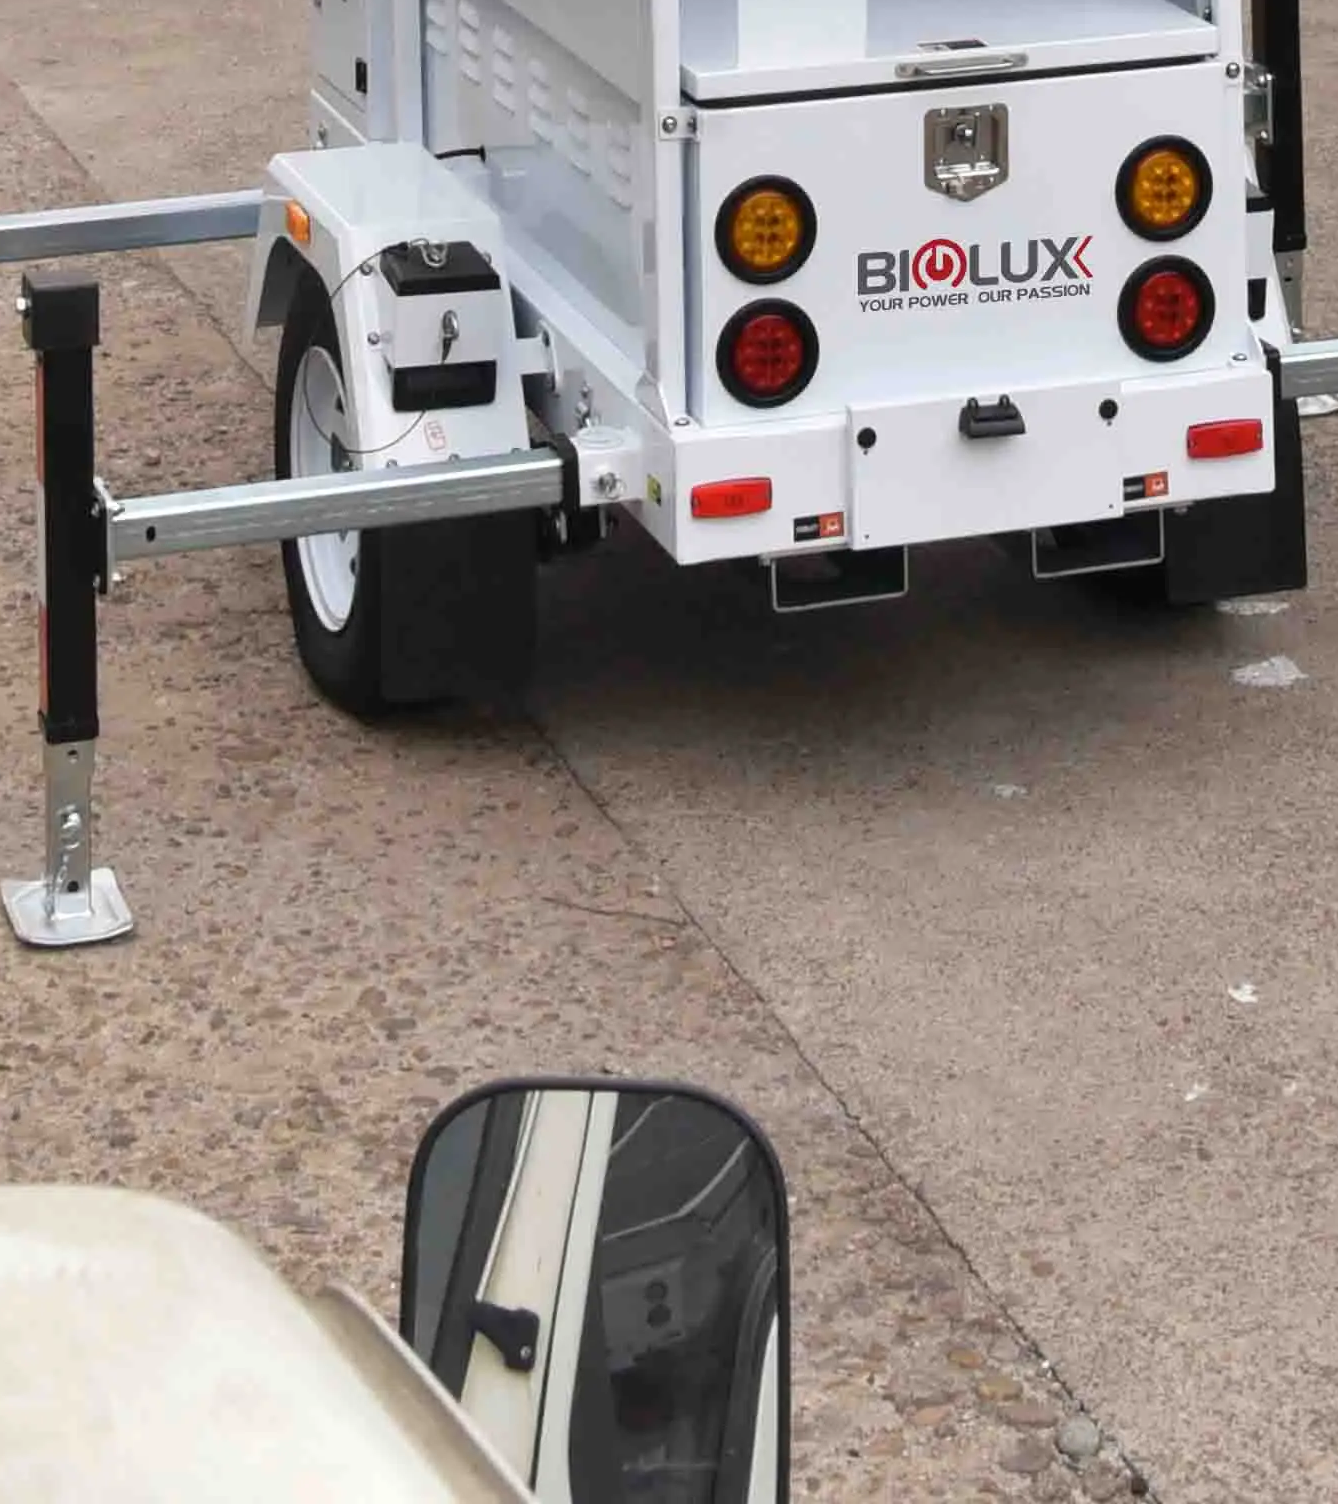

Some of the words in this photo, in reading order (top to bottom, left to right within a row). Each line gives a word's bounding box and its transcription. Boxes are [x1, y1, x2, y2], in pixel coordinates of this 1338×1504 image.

[860, 297, 903, 313] YOUR
[909, 292, 969, 309] POWER
[978, 288, 1012, 304] OUR
[1017, 283, 1091, 302] PASSION
